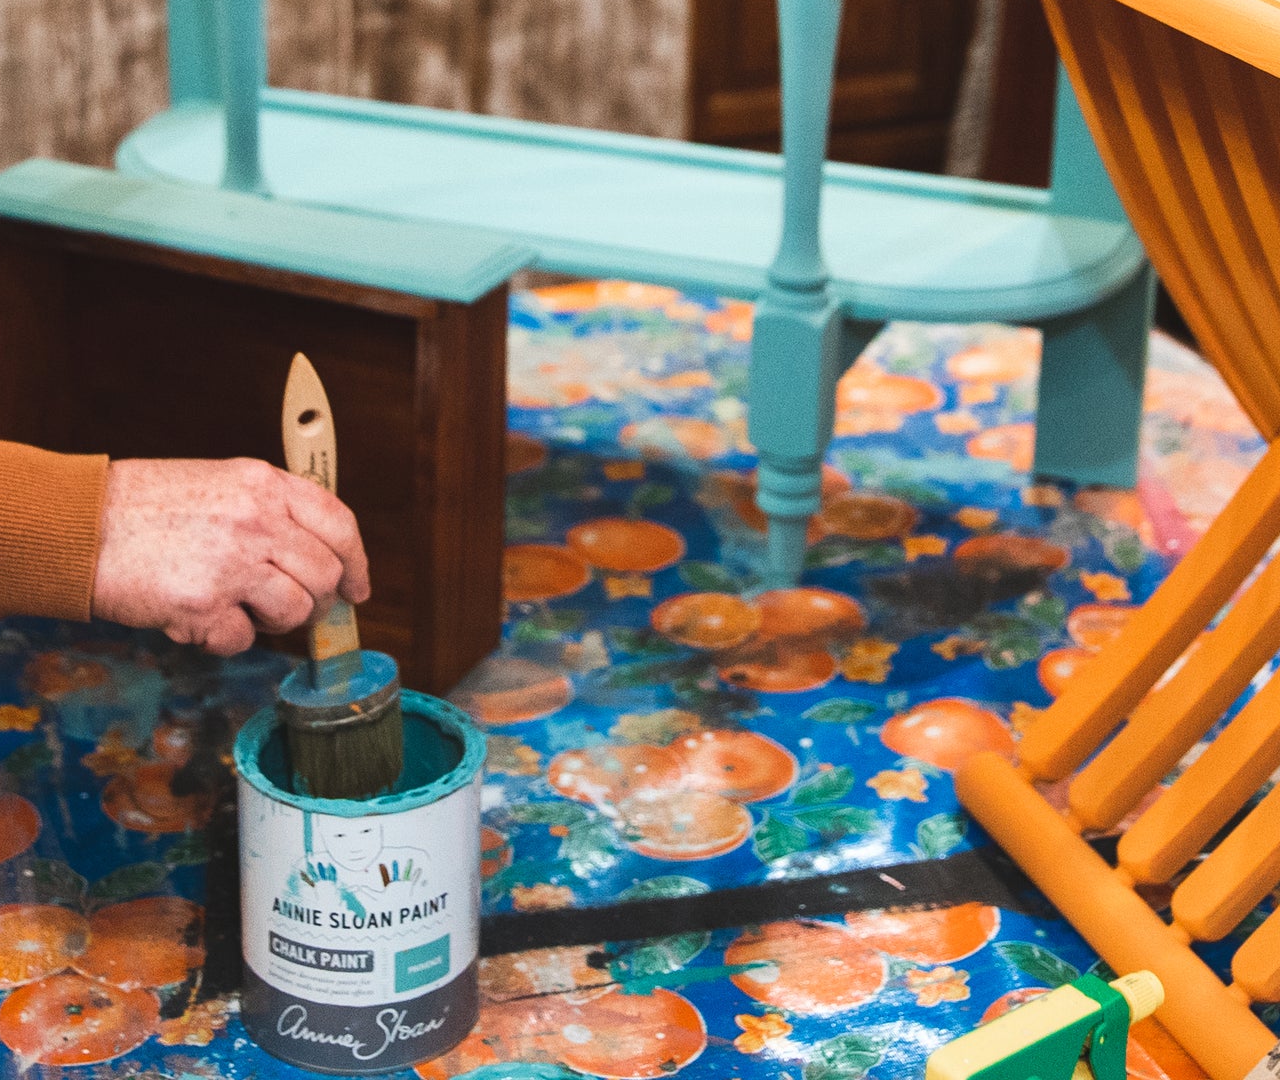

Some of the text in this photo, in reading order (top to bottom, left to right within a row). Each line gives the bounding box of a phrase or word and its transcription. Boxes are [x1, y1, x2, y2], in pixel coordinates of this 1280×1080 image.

[272, 892, 448, 930] ANNIE SLOAN PAINT
[271, 936, 370, 970] CHALK PAINT
[276, 1004, 366, 1049] Annie
